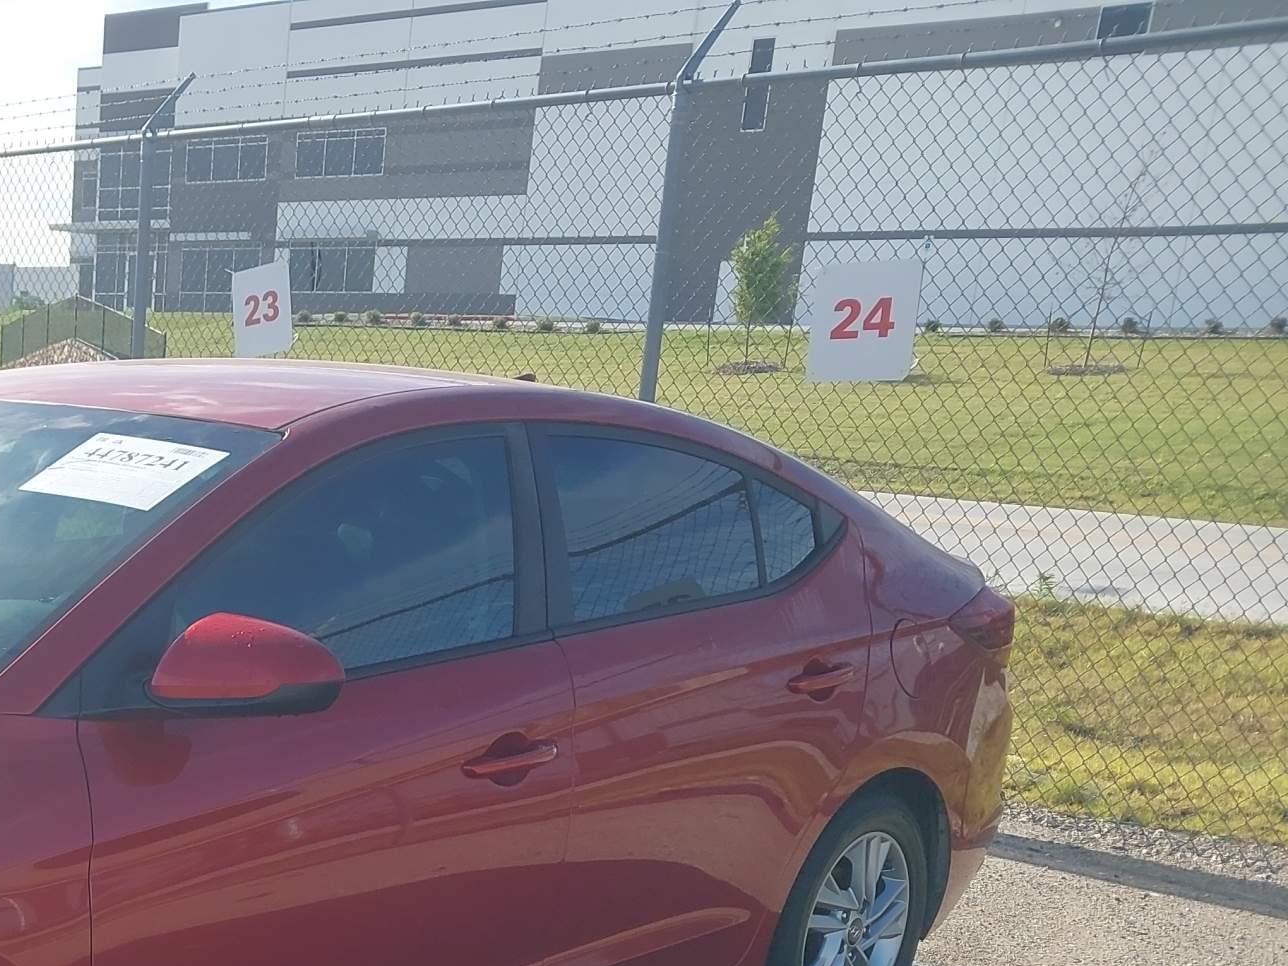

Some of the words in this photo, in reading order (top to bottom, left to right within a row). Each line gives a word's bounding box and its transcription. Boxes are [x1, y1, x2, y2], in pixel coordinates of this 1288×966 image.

[243, 290, 280, 327] 23
[829, 296, 895, 340] 24
[85, 447, 189, 472] 44787241
